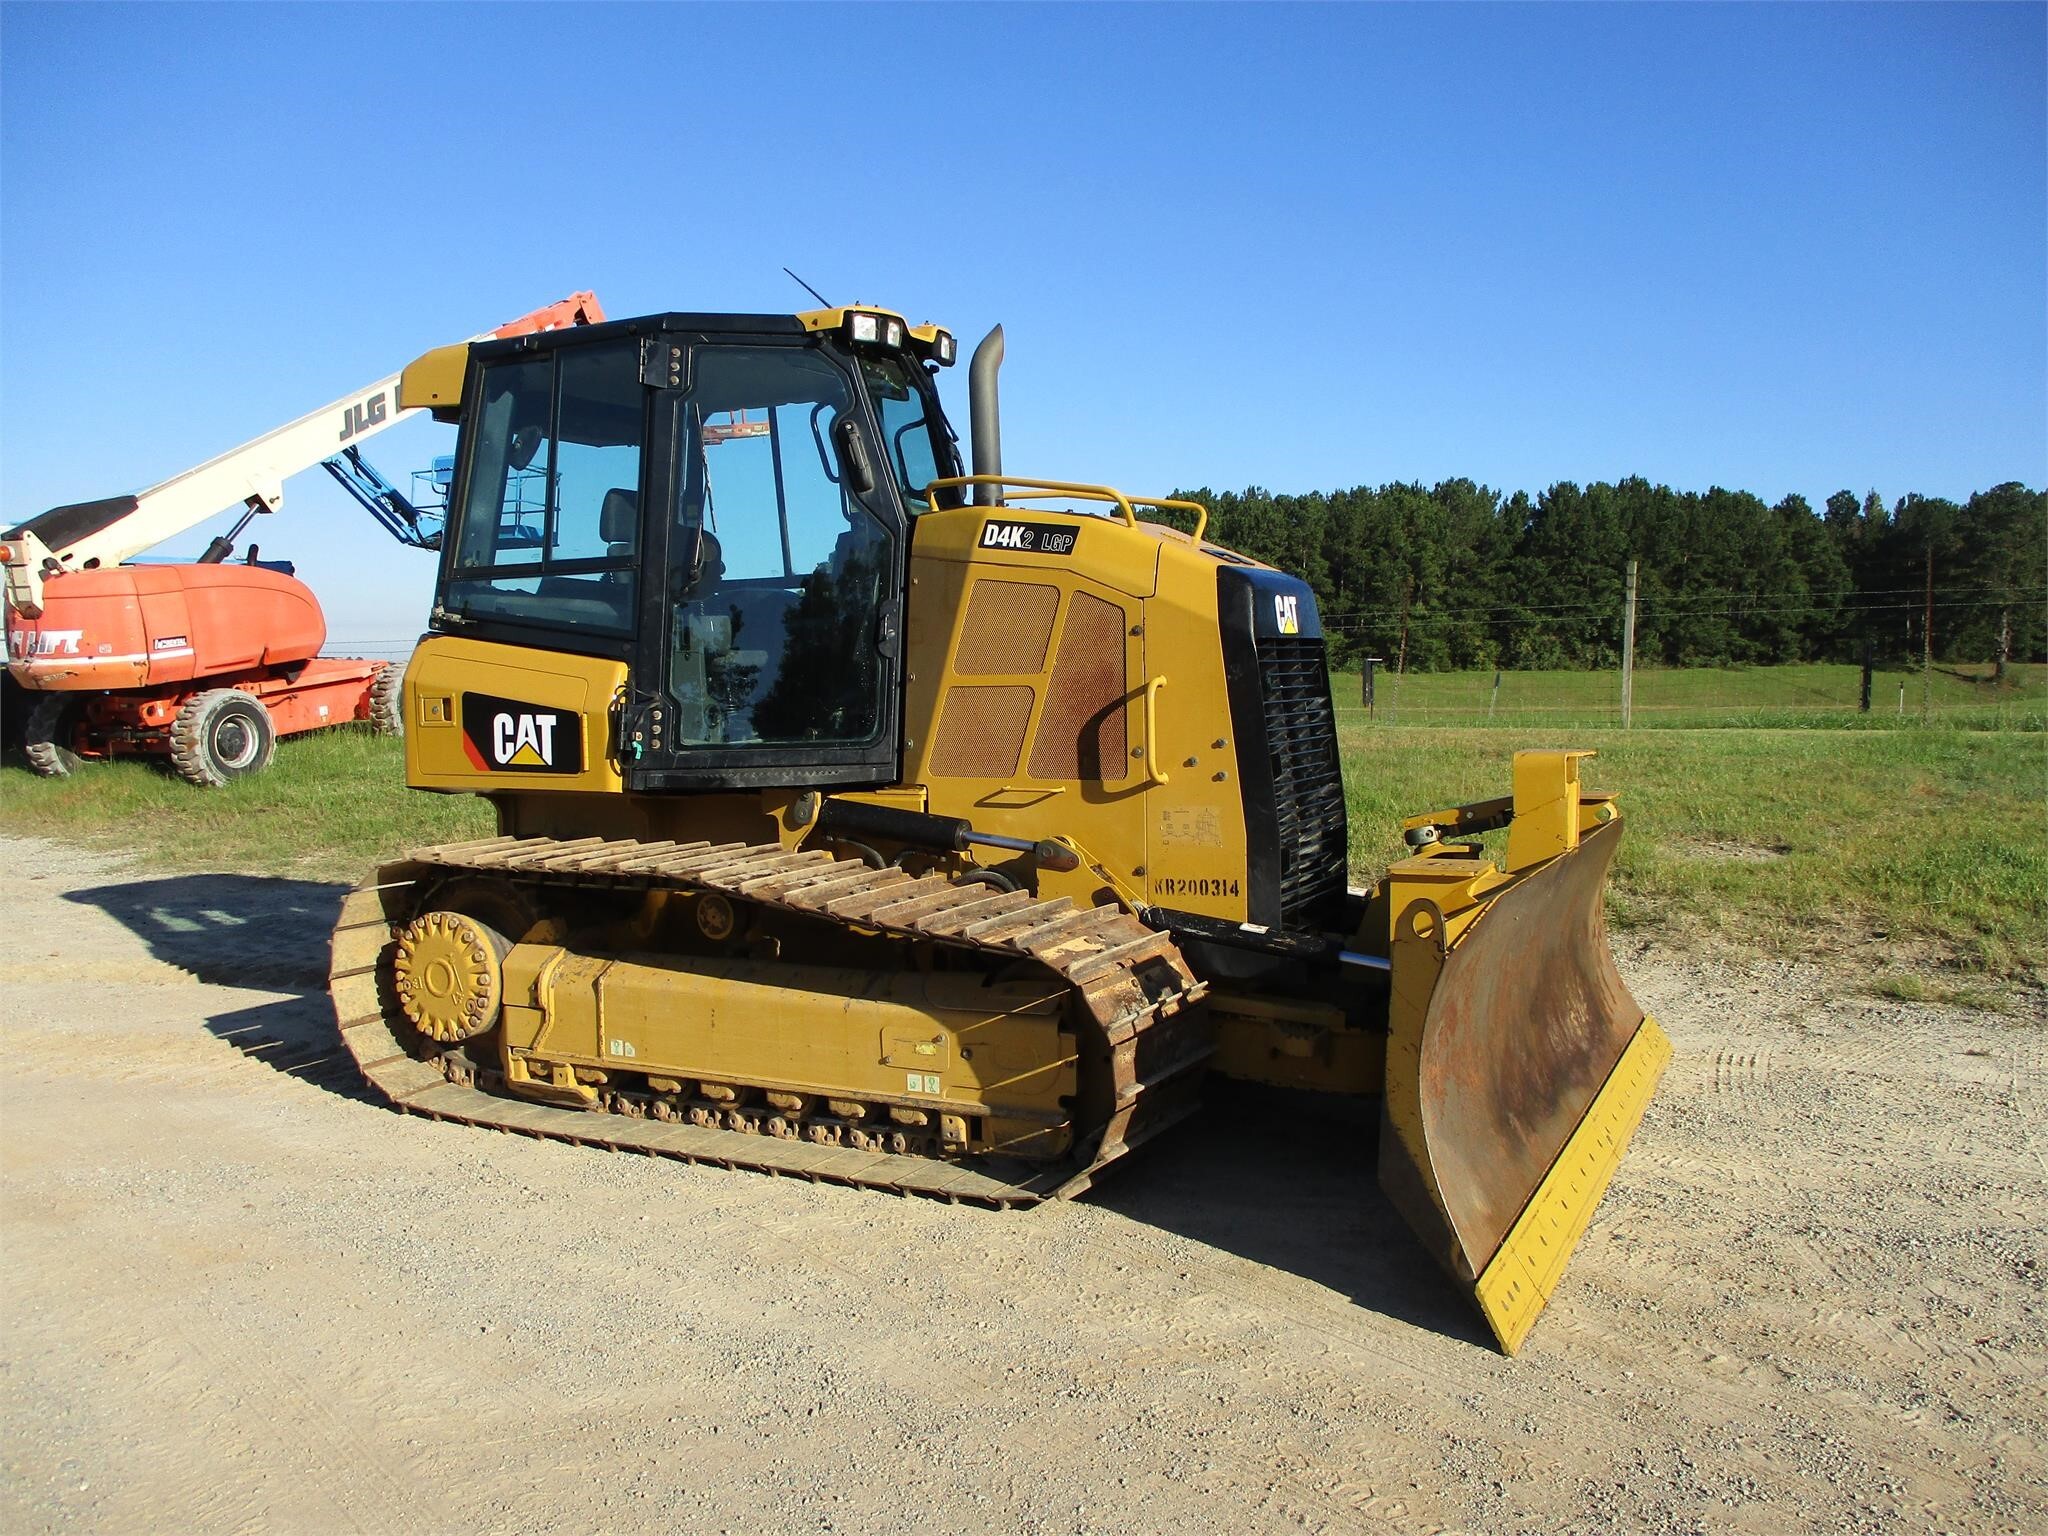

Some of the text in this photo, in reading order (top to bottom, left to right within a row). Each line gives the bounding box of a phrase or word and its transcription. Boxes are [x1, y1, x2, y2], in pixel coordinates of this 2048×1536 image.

[340, 392, 386, 441] JLG
[983, 524, 1073, 552] D4K2 LGP
[1274, 594, 1299, 634] CAT
[493, 712, 557, 766] CAT
